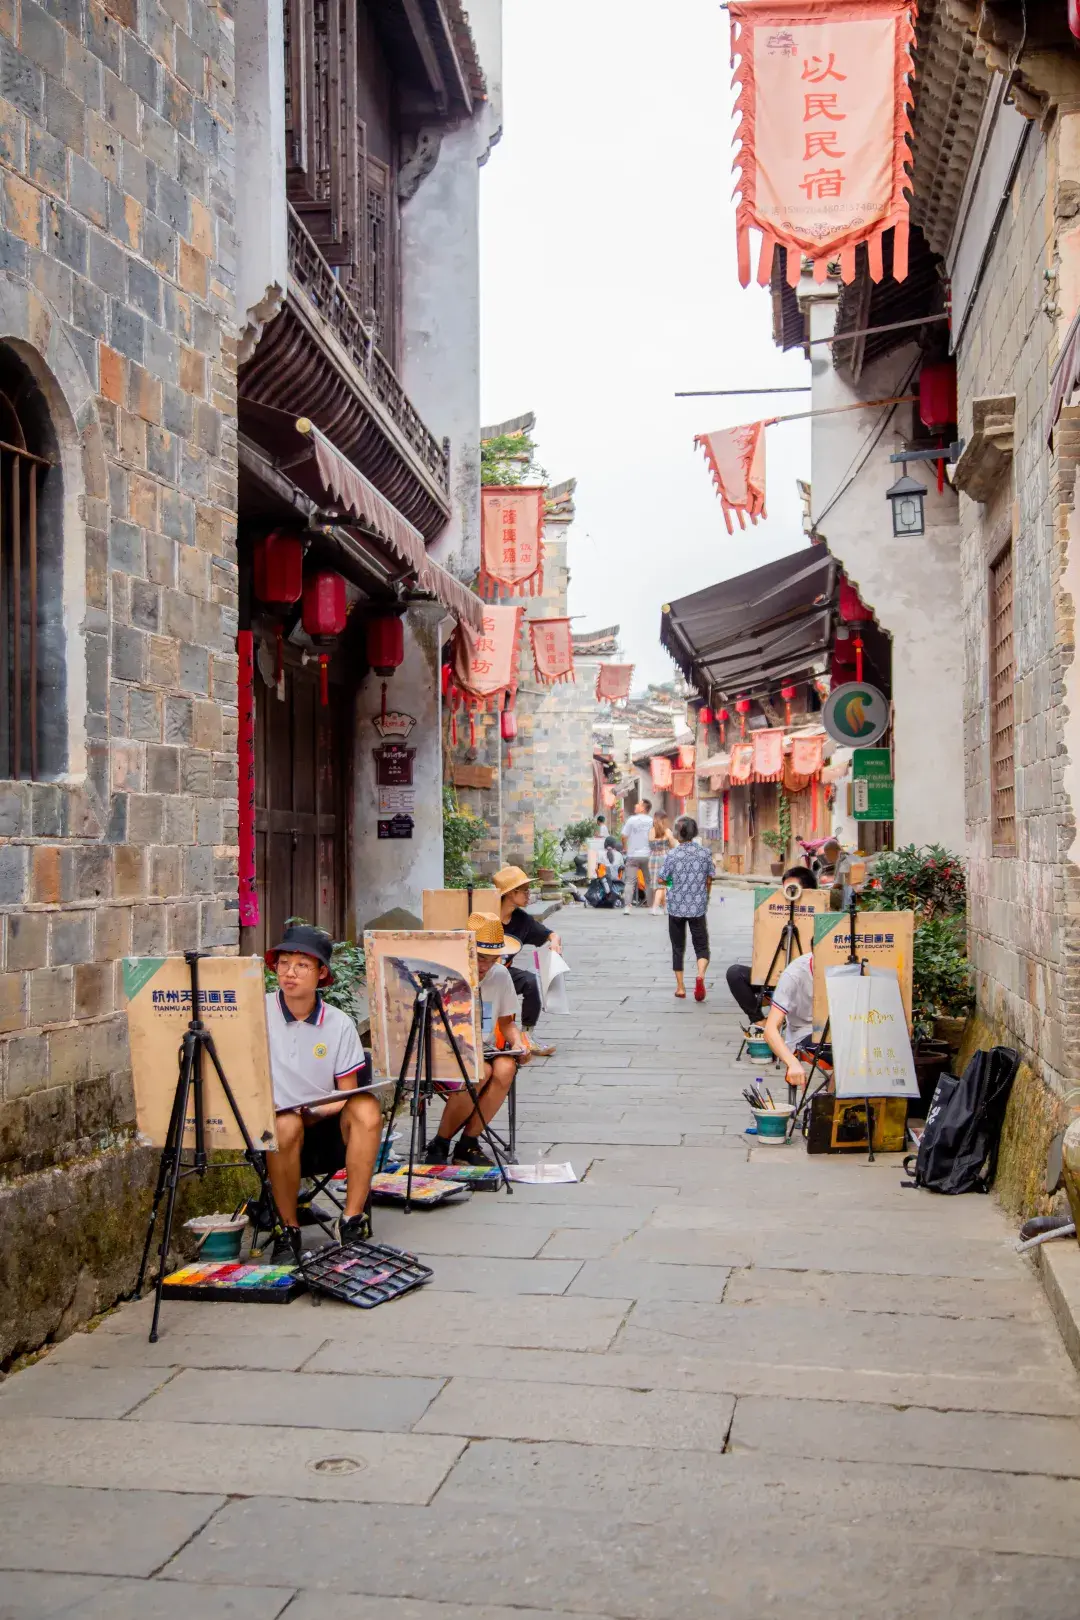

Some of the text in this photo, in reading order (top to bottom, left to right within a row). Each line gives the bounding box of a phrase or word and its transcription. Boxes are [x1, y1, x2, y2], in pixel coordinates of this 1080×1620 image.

[799, 53, 847, 200] 以民民宿
[834, 934, 894, 943] 杭州天目画室
[152, 990, 236, 1003] 杭州天目画室
